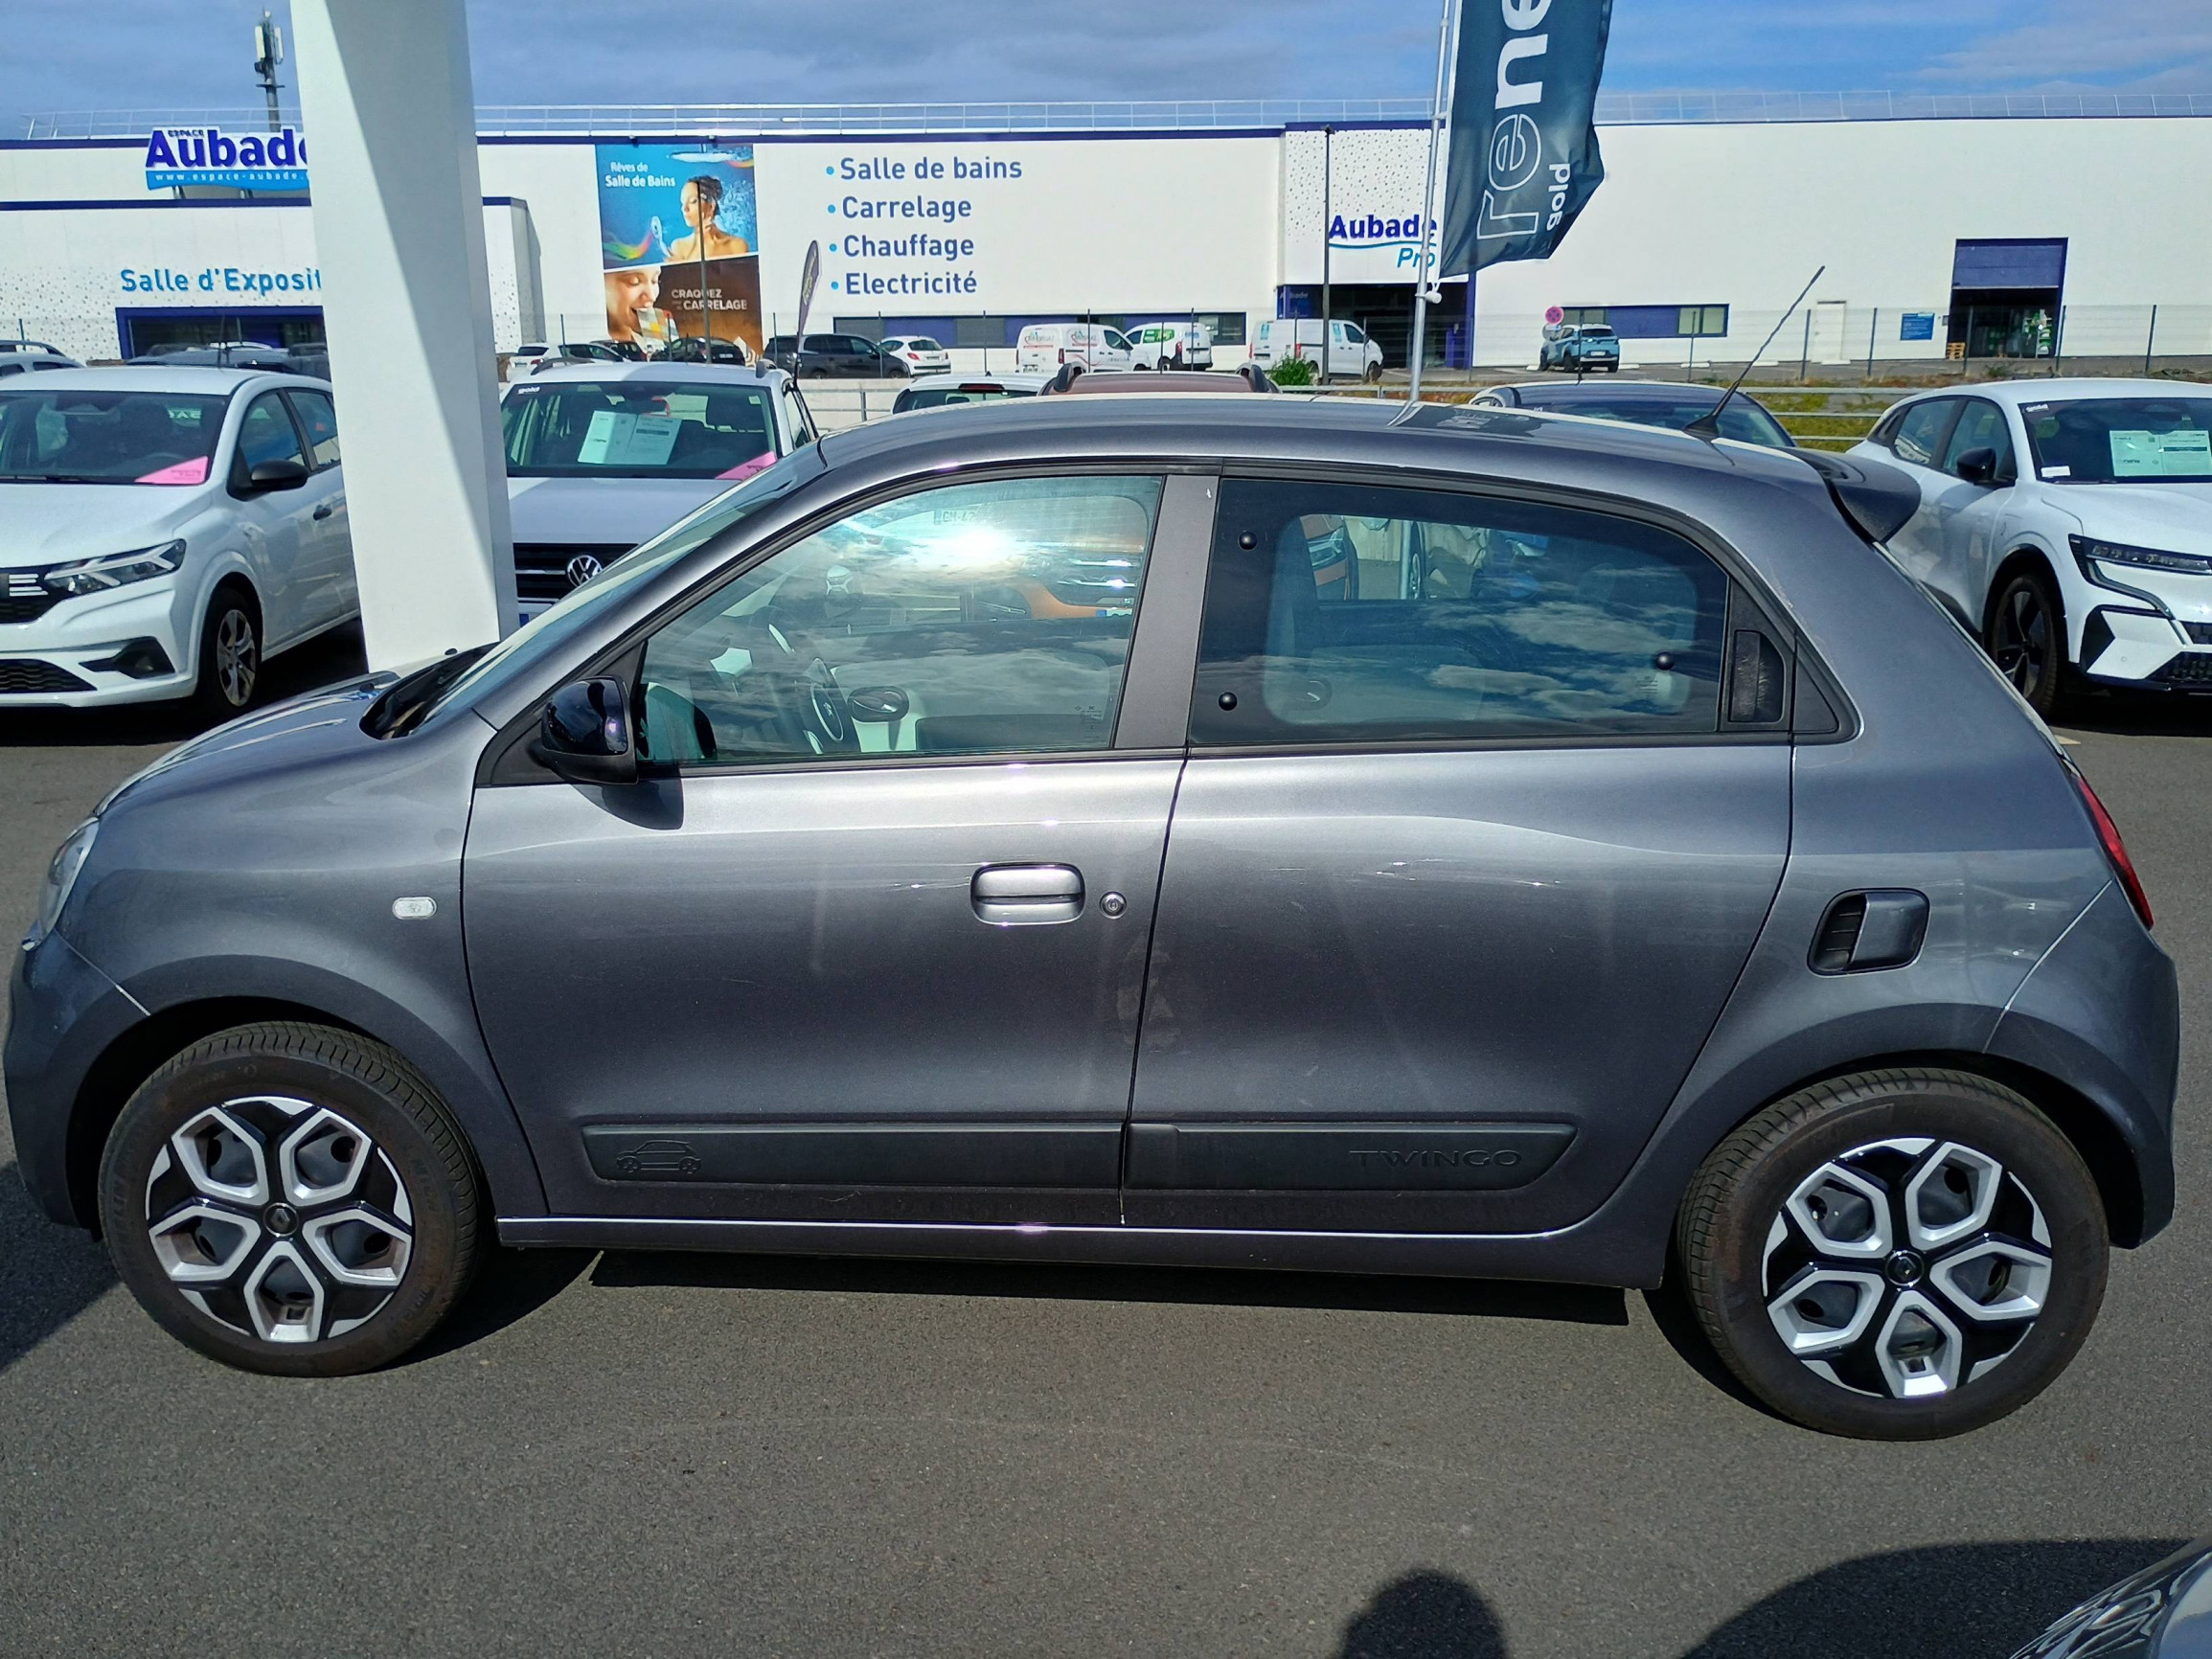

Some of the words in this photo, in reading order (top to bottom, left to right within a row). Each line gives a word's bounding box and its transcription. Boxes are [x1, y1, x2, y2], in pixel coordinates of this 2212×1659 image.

[155, 171, 310, 183] www.espace-aubade.
[636, 161, 649, 172] de
[840, 156, 906, 181] Salle
[914, 156, 945, 180] de
[953, 156, 1023, 180] bains
[604, 174, 630, 188] Salle
[631, 174, 646, 188] de
[647, 174, 676, 187] Bains
[842, 195, 972, 223] Carrelage
[1546, 162, 1571, 232] gold
[843, 234, 975, 261] Chauffage
[120, 268, 189, 292] Salle
[846, 270, 978, 295] Electricité
[1349, 1149, 1522, 1168] TWINGO
